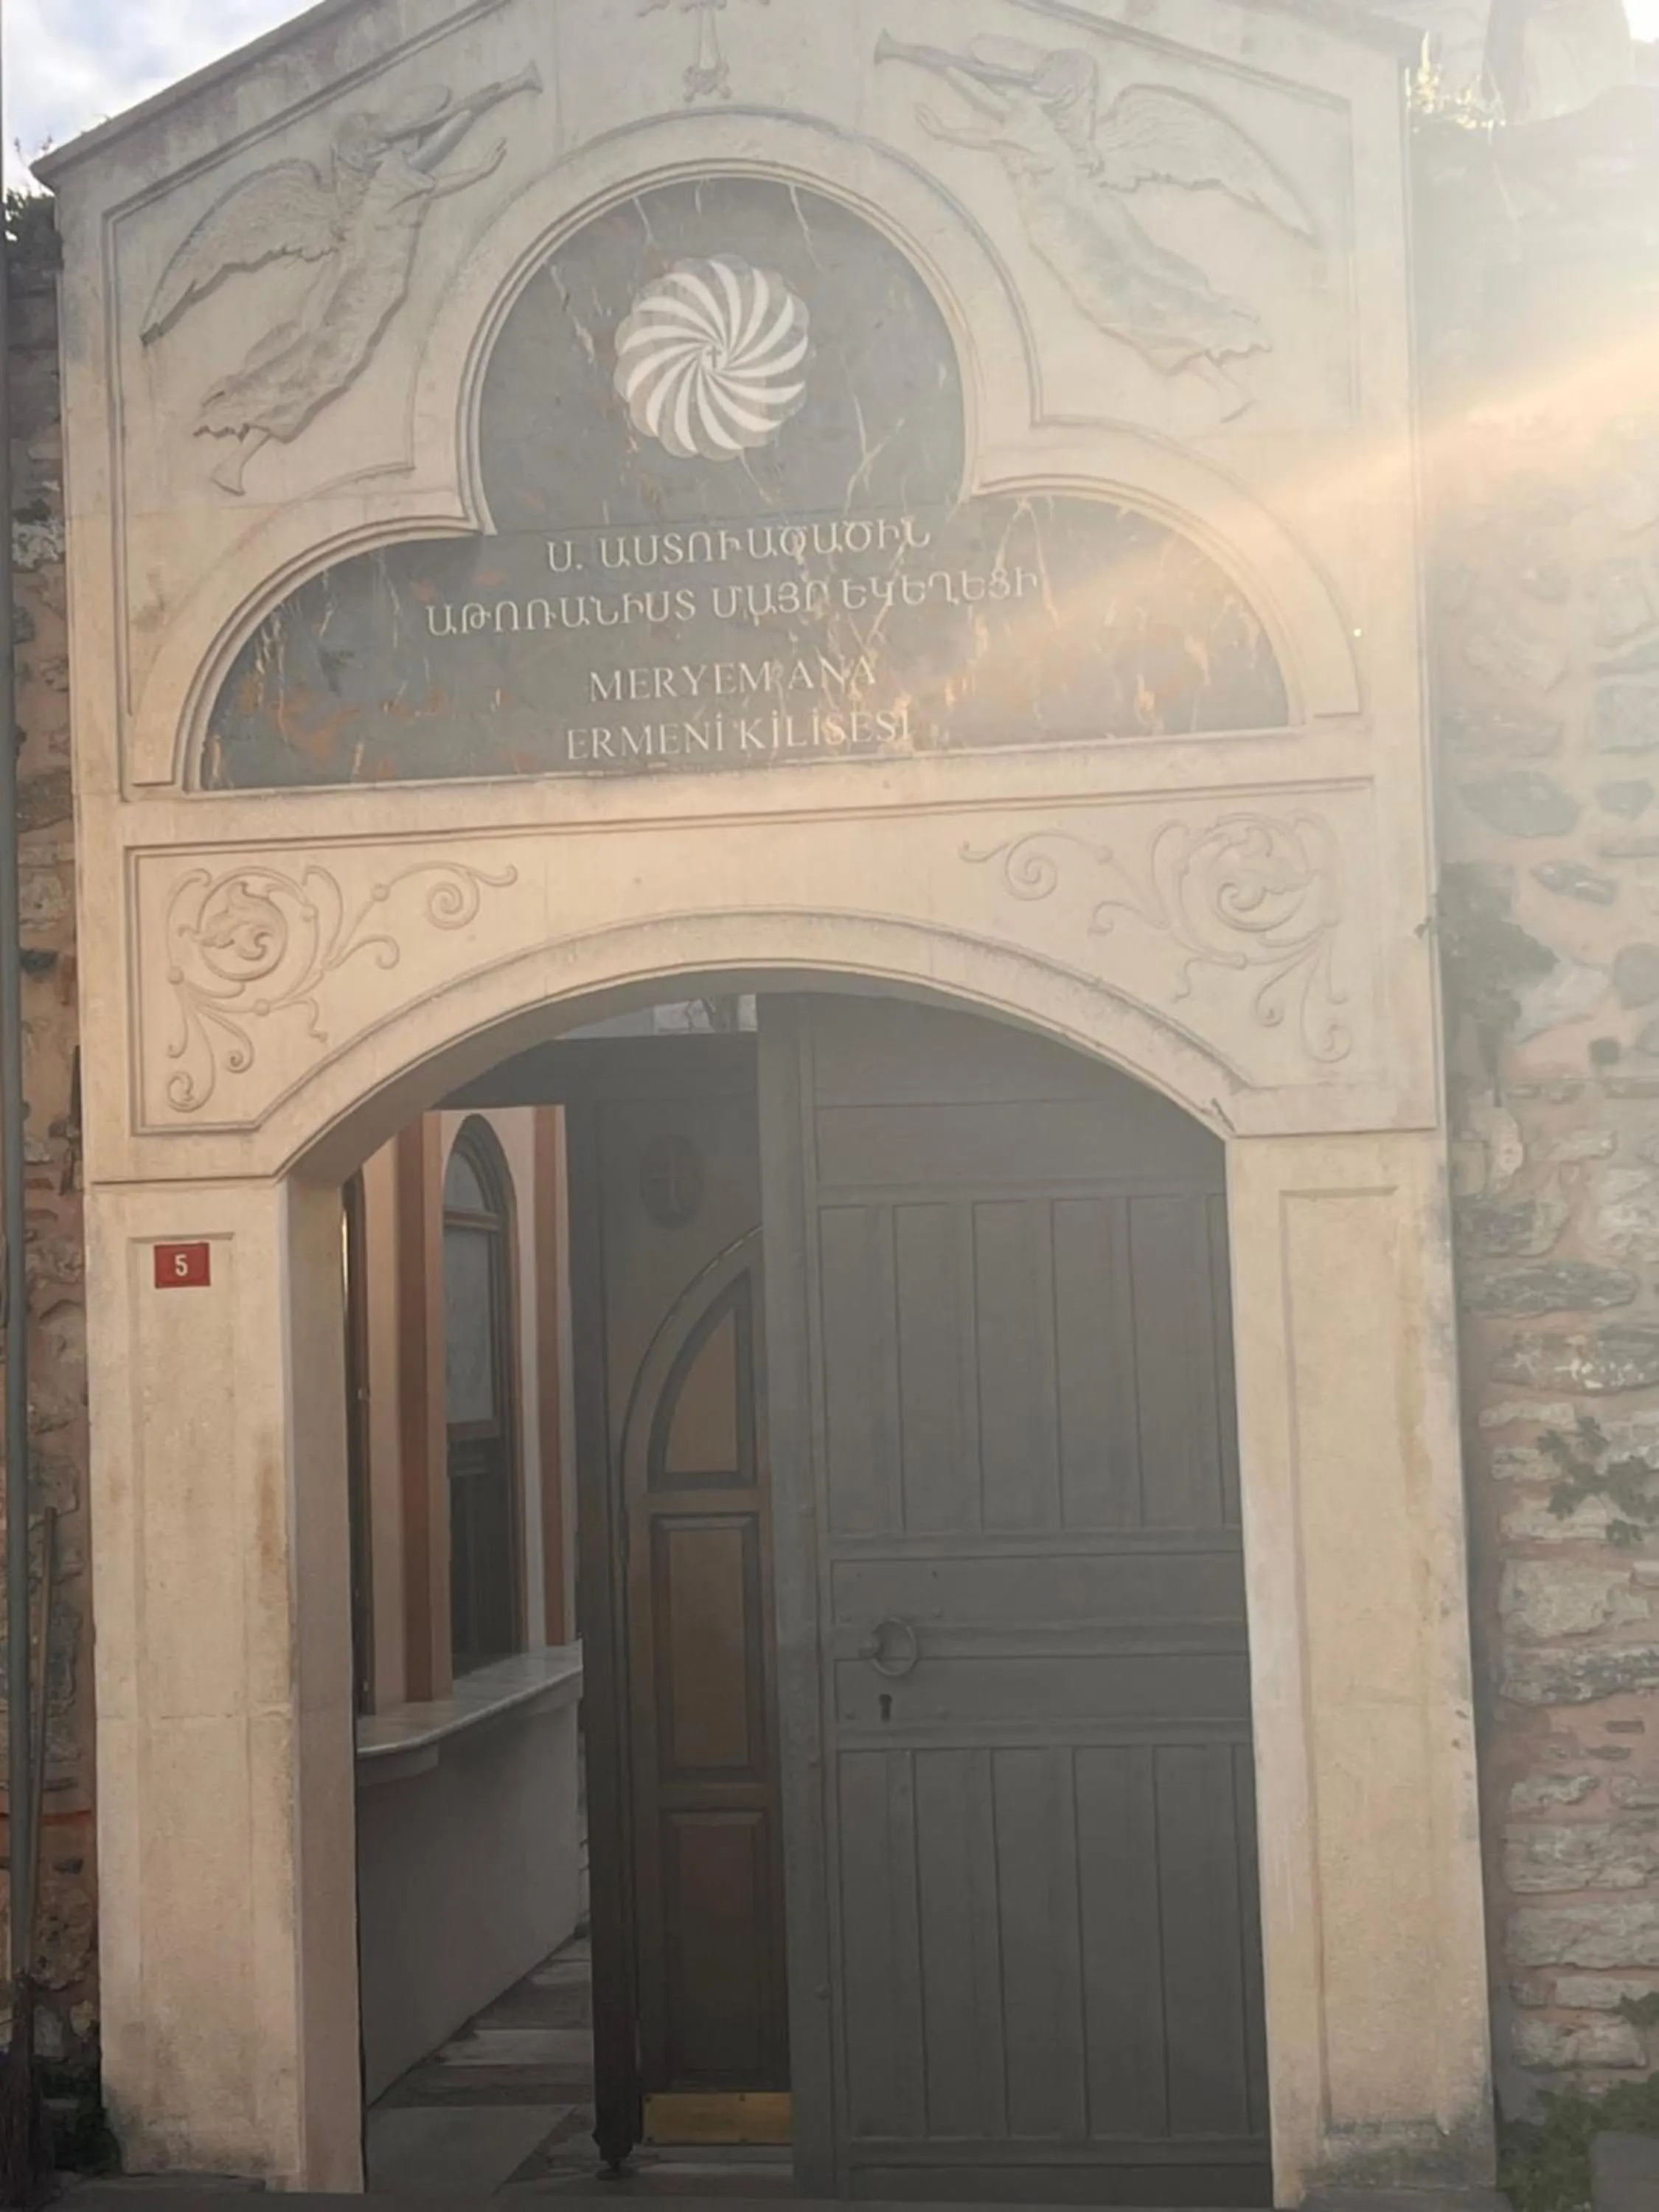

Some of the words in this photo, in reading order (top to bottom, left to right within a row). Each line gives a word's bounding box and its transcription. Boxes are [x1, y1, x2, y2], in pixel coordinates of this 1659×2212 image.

[590, 660, 771, 702] MERYEM
[788, 655, 877, 691] ANA
[566, 713, 725, 760] ERMENİ
[175, 1253, 189, 1277] 5
